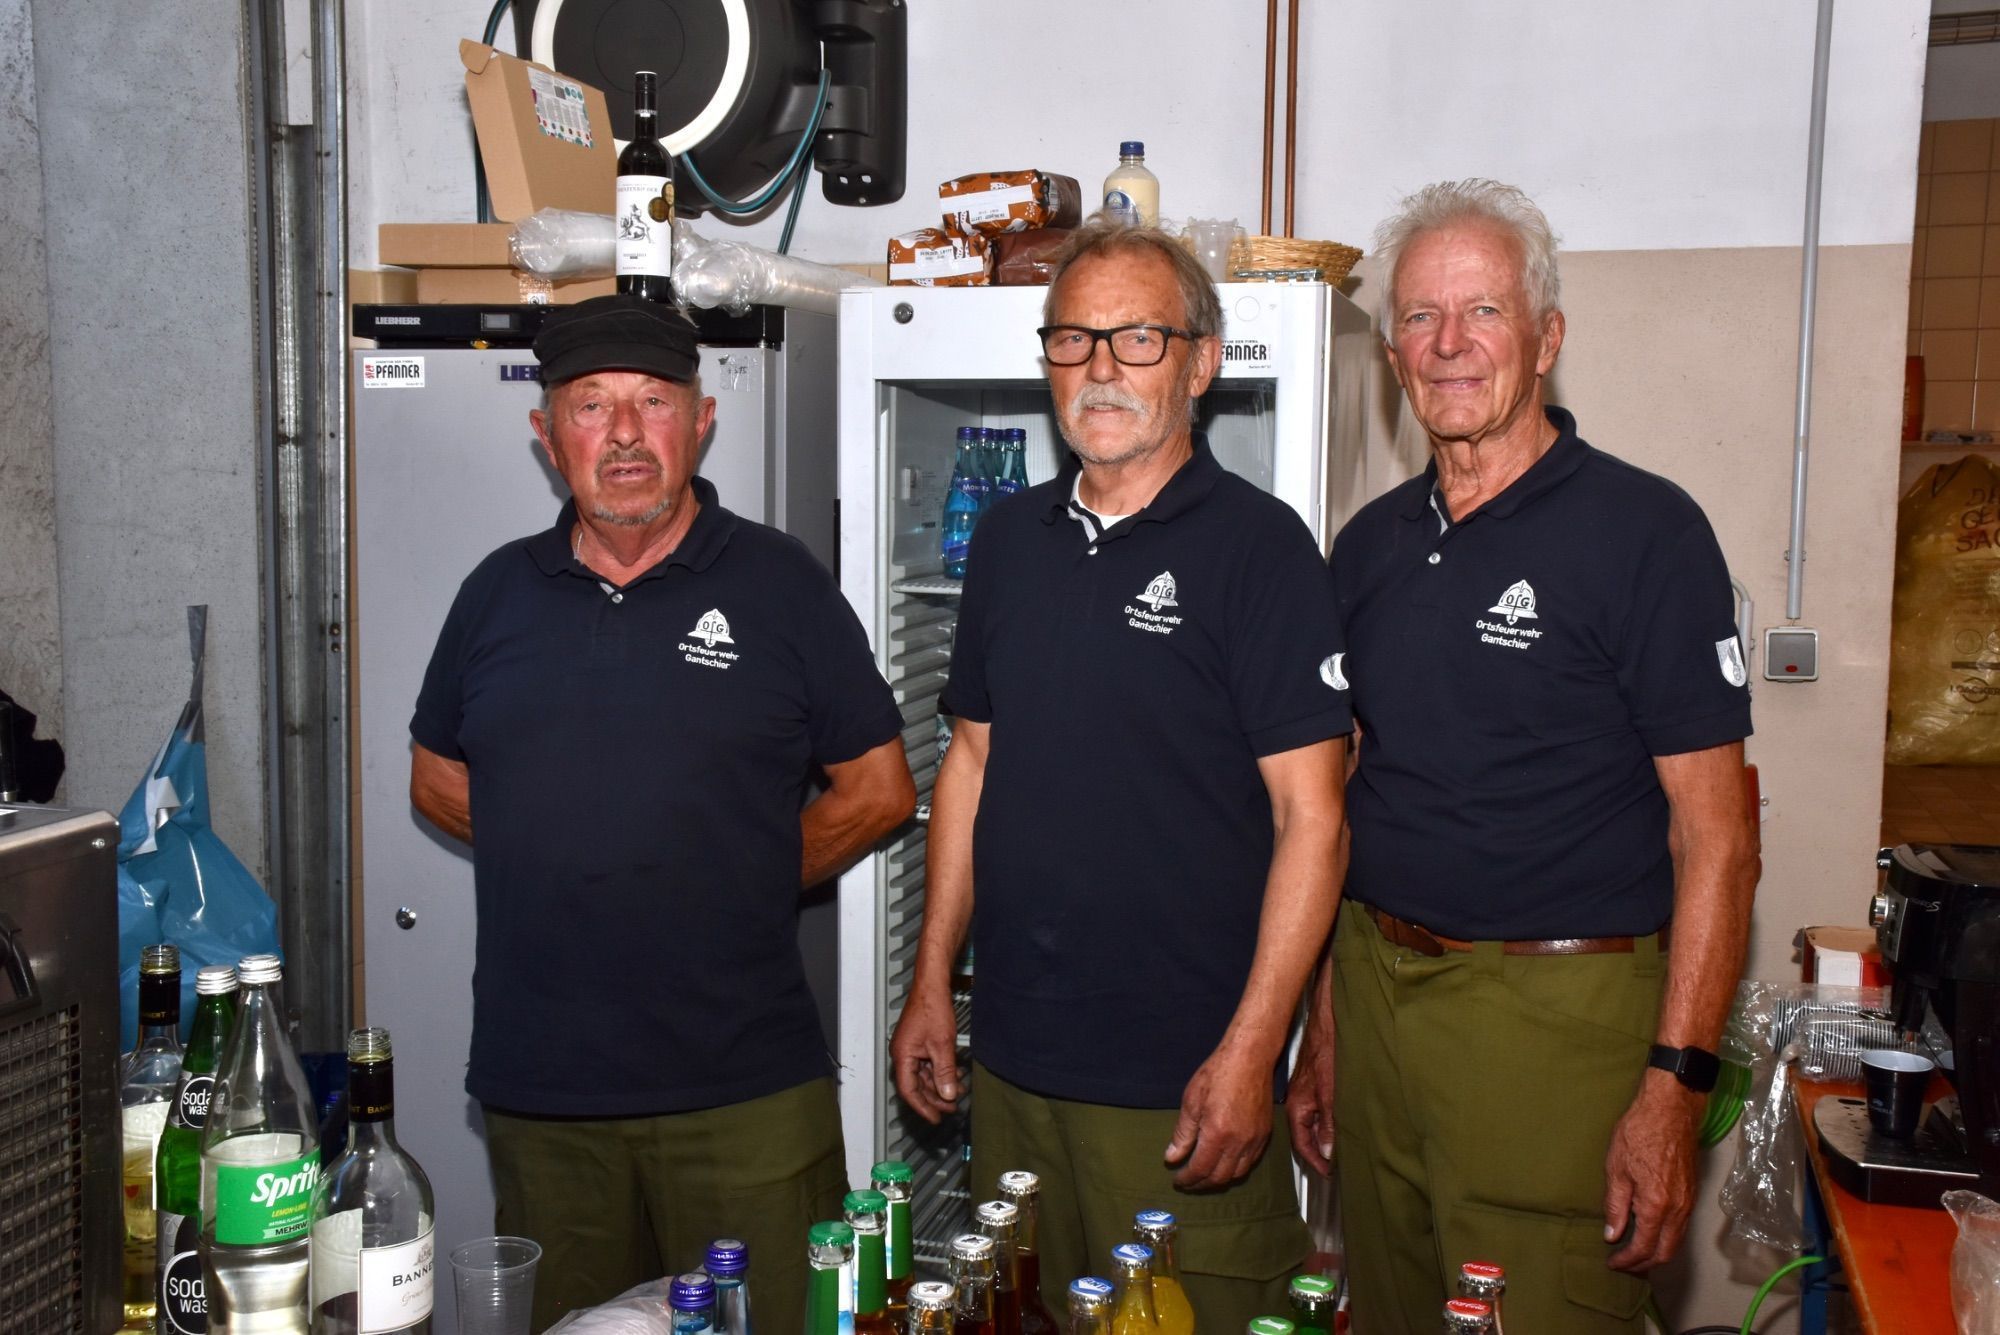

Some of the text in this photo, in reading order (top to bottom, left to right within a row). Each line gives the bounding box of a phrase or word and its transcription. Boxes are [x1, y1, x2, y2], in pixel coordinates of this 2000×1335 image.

[375, 316, 421, 326] LIEBHERR
[376, 364, 420, 379] PFANNER
[1124, 605, 1183, 625] Ortsfeuerwehr
[1128, 617, 1173, 635] Gantschier
[1475, 619, 1543, 638] Ortsfeuerwehr
[1480, 633, 1531, 650] Gantschier
[678, 642, 739, 661] Ortsfeuerwehr
[685, 653, 730, 670] Gantschier
